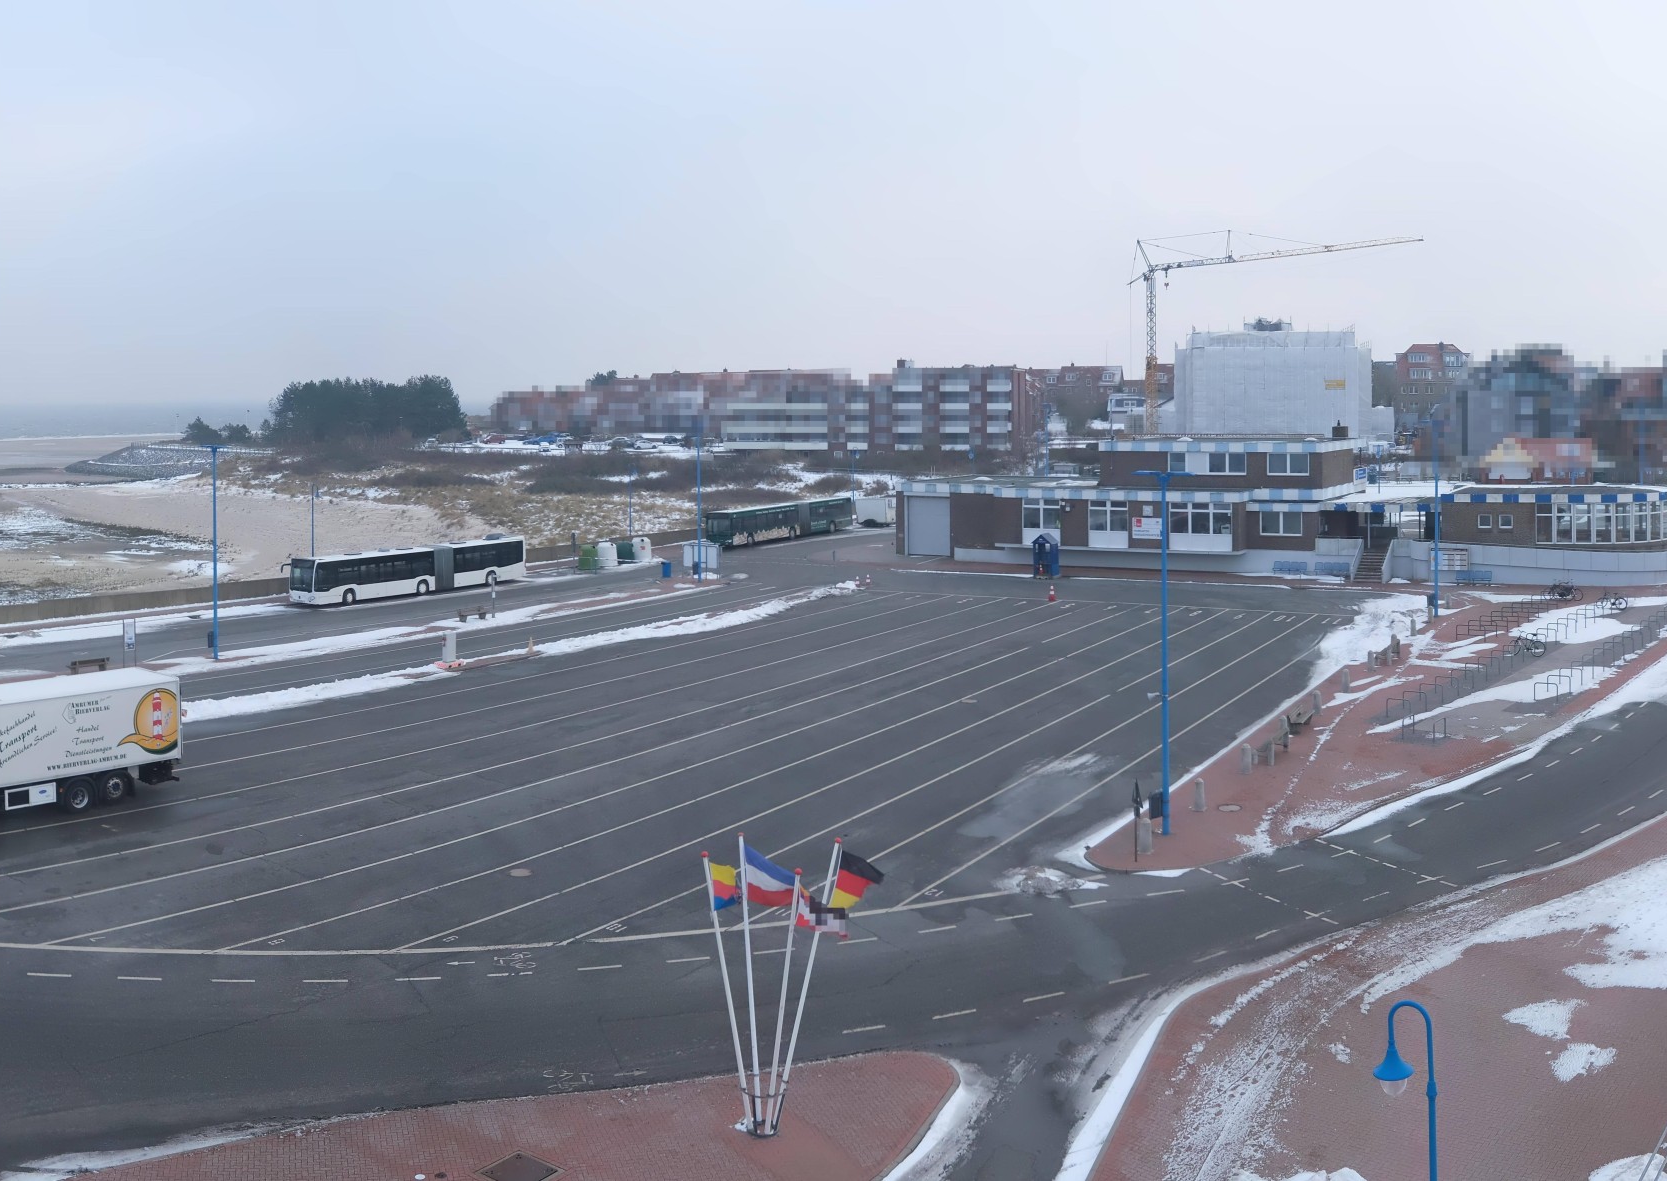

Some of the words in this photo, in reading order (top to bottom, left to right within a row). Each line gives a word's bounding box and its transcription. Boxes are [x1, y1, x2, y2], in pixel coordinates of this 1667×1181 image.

[71, 700, 99, 708] AMRUMER
[75, 705, 110, 714] BIERVERLAG
[76, 725, 99, 733] Handel
[72, 736, 104, 746] Transport
[65, 746, 112, 758] Dienstleistungen
[925, 889, 944, 897] 12
[606, 923, 627, 932] 10
